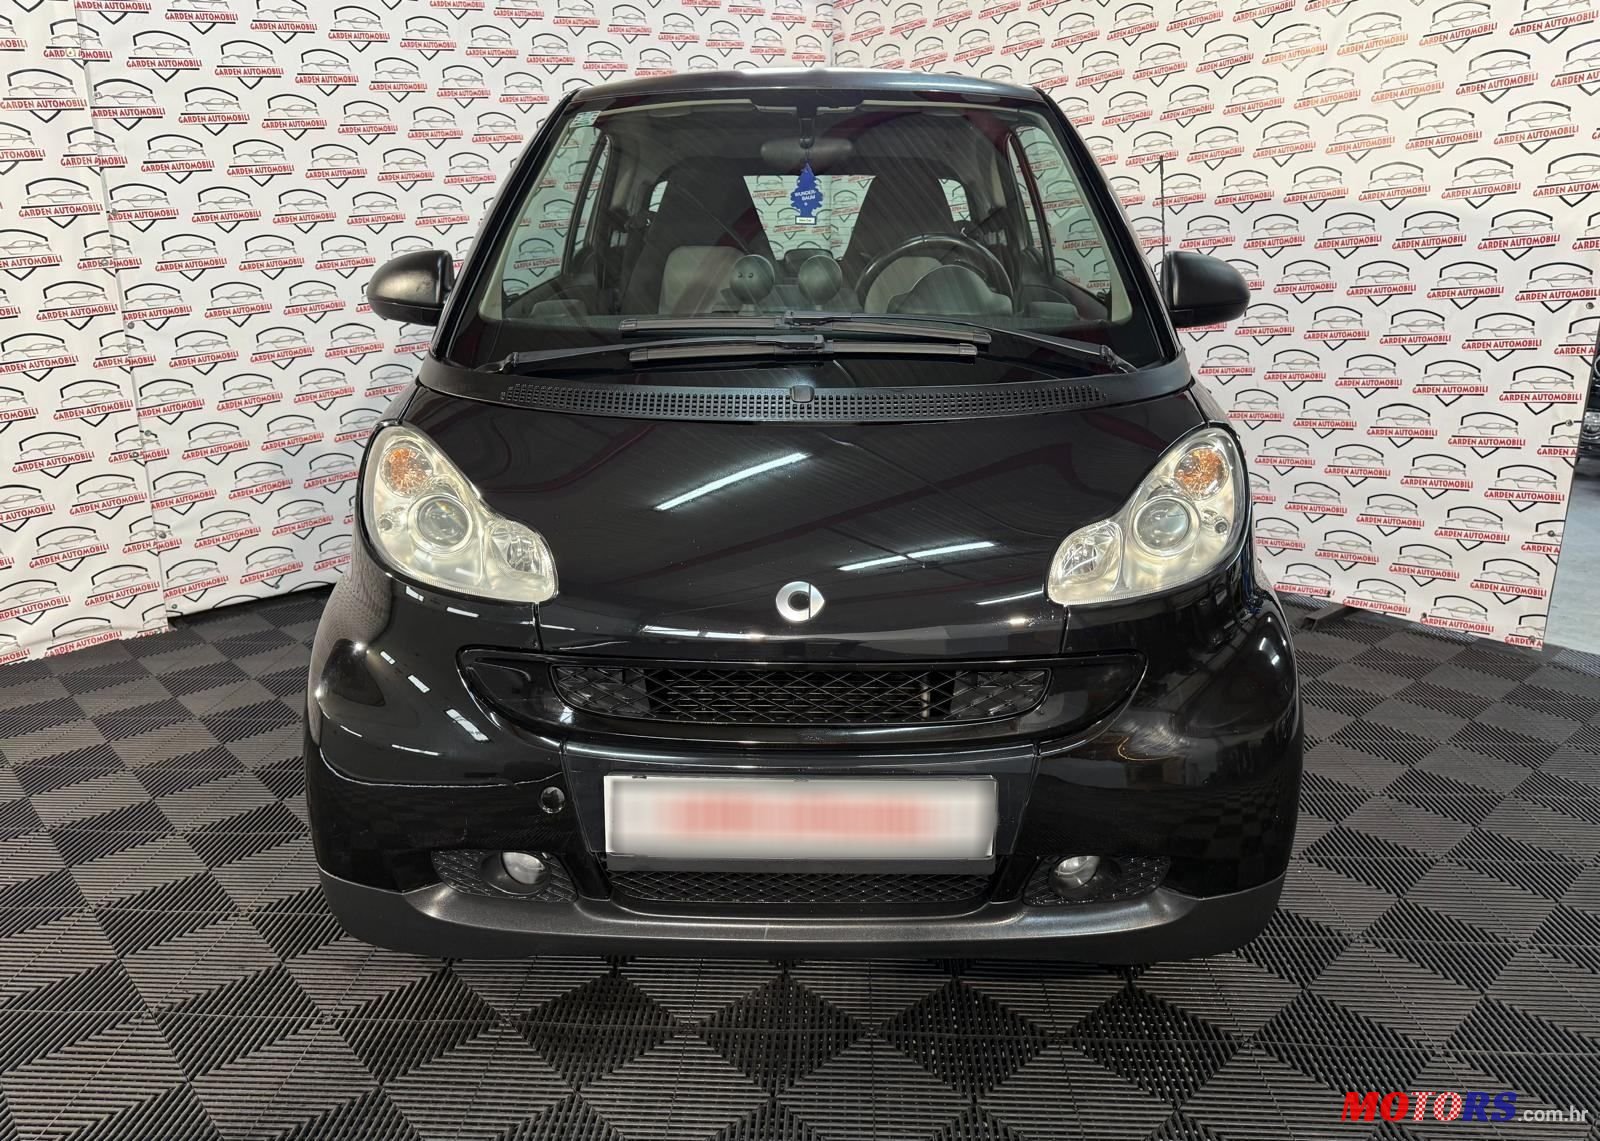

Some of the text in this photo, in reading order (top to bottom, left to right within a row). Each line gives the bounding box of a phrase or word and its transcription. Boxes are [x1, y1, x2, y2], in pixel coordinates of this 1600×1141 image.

[166, 12, 237, 21] GARDEN AUTOMOBILI
[1509, 12, 1600, 35] GARDEN AUTOMOBILI
[250, 22, 317, 31] GARDEN AUTOMOBILI
[1106, 21, 1160, 40] GARDEN AUTOMOBILI
[328, 32, 390, 40] GARDEN AUTOMOBILI
[1418, 24, 1497, 46] GARDEN AUTOMOBILI
[422, 41, 457, 49] AUTOMOBILI
[465, 48, 518, 57] GARDEN AUTOMOBILI
[1336, 34, 1409, 56] GARDEN AUTOMOBILI
[1260, 44, 1329, 64] GARDEN AUTOMOBILI
[127, 59, 202, 68] GARDEN AUTOMOBILI
[214, 68, 286, 77] GARDEN AUTOMOBILI
[294, 75, 359, 85] GARDEN AUTOMOBILI
[1372, 82, 1445, 103] GARDEN AUTOMOBILI
[1456, 74, 1539, 95] GARDEN AUTOMOBILI
[436, 89, 492, 98] GARDEN AUTOMOBILI
[0, 99, 86, 110] GARDEN AUTOMOBILI
[1222, 97, 1286, 115] GARDEN AUTOMOBILI
[178, 114, 249, 124] GARDEN AUTOMOBILI
[261, 119, 328, 130] GARDEN AUTOMOBILI
[1404, 131, 1482, 150] GARDEN AUTOMOBILI
[1494, 126, 1580, 144] GARDEN AUTOMOBILI
[1324, 136, 1396, 155] GARDEN AUTOMOBILI
[140, 161, 215, 172] GARDEN AUTOMOBILI
[226, 164, 295, 176] GARDEN AUTOMOBILI
[304, 168, 368, 179] GARDEN AUTOMOBILI
[1215, 191, 1276, 206] GARDEN AUTOMOBILI
[1284, 187, 1351, 204] GARDEN AUTOMOBILI
[1356, 185, 1431, 202] GARDEN AUTOMOBILI
[1440, 184, 1521, 200] GARDEN AUTOMOBILI
[19, 203, 104, 219] GARDEN AUTOMOBILI
[191, 210, 262, 223] GARDEN AUTOMOBILI
[272, 212, 337, 224] GARDEN AUTOMOBILI
[1314, 234, 1383, 250] GARDEN AUTOMOBILI
[1392, 234, 1468, 250] GARDEN AUTOMOBILI
[1476, 234, 1562, 250] GARDEN AUTOMOBILI
[155, 257, 228, 272] GARDEN AUTOMOBILI
[237, 256, 305, 272] GARDEN AUTOMOBILI
[1344, 283, 1418, 297] GARDEN AUTOMOBILI
[1425, 286, 1505, 300] GARDEN AUTOMOBILI
[36, 304, 119, 321] GARDEN AUTOMOBILI
[204, 304, 273, 320] GARDEN AUTOMOBILI
[284, 300, 347, 316] GARDEN AUTOMOBILI
[1303, 329, 1370, 340] GARDEN AUTOMOBILI
[1379, 334, 1452, 346] GARDEN AUTOMOBILI
[1462, 339, 1542, 351] GARDEN AUTOMOBILI
[168, 351, 240, 368] GARDEN AUTOMOBILI
[250, 346, 316, 364] GARDEN AUTOMOBILI
[1334, 378, 1403, 388] GARDEN AUTOMOBILI
[1410, 384, 1489, 395] GARDEN AUTOMOBILI
[216, 392, 284, 412] GARDEN AUTOMOBILI
[294, 386, 356, 404] GARDEN AUTOMOBILI
[1498, 392, 1584, 402] GARDEN AUTOMOBILI
[52, 400, 134, 421] GARDEN AUTOMOBILI
[1366, 428, 1440, 438] GARDEN AUTOMOBILI
[181, 440, 251, 460] GARDEN AUTOMOBILI
[260, 432, 325, 452] GARDEN AUTOMOBILI
[1447, 436, 1528, 448] GARDEN AUTOMOBILI
[12, 451, 95, 473] GARDEN AUTOMOBILI
[227, 480, 292, 500] GARDEN AUTOMOBILI
[1400, 477, 1474, 490] GARDEN AUTOMOBILI
[68, 492, 149, 516] GARDEN AUTOMOBILI
[1484, 490, 1566, 502] GARDEN AUTOMOBILI
[272, 516, 333, 536] GARDEN AUTOMOBILI
[1356, 516, 1425, 528] GARDEN AUTOMOBILI
[193, 527, 262, 548] GARDEN AUTOMOBILI
[1433, 530, 1512, 542] GARDEN AUTOMOBILI
[26, 544, 110, 569] GARDEN AUTOMOBILI
[239, 562, 304, 585] GARDEN AUTOMOBILI
[1387, 564, 1462, 580] GARDEN AUTOMOBILI
[84, 582, 160, 607] GARDEN AUTOMOBILI
[1468, 582, 1548, 598] GARDEN AUTOMOBILI
[1342, 599, 1411, 614] GARDEN AUTOMOBILI
